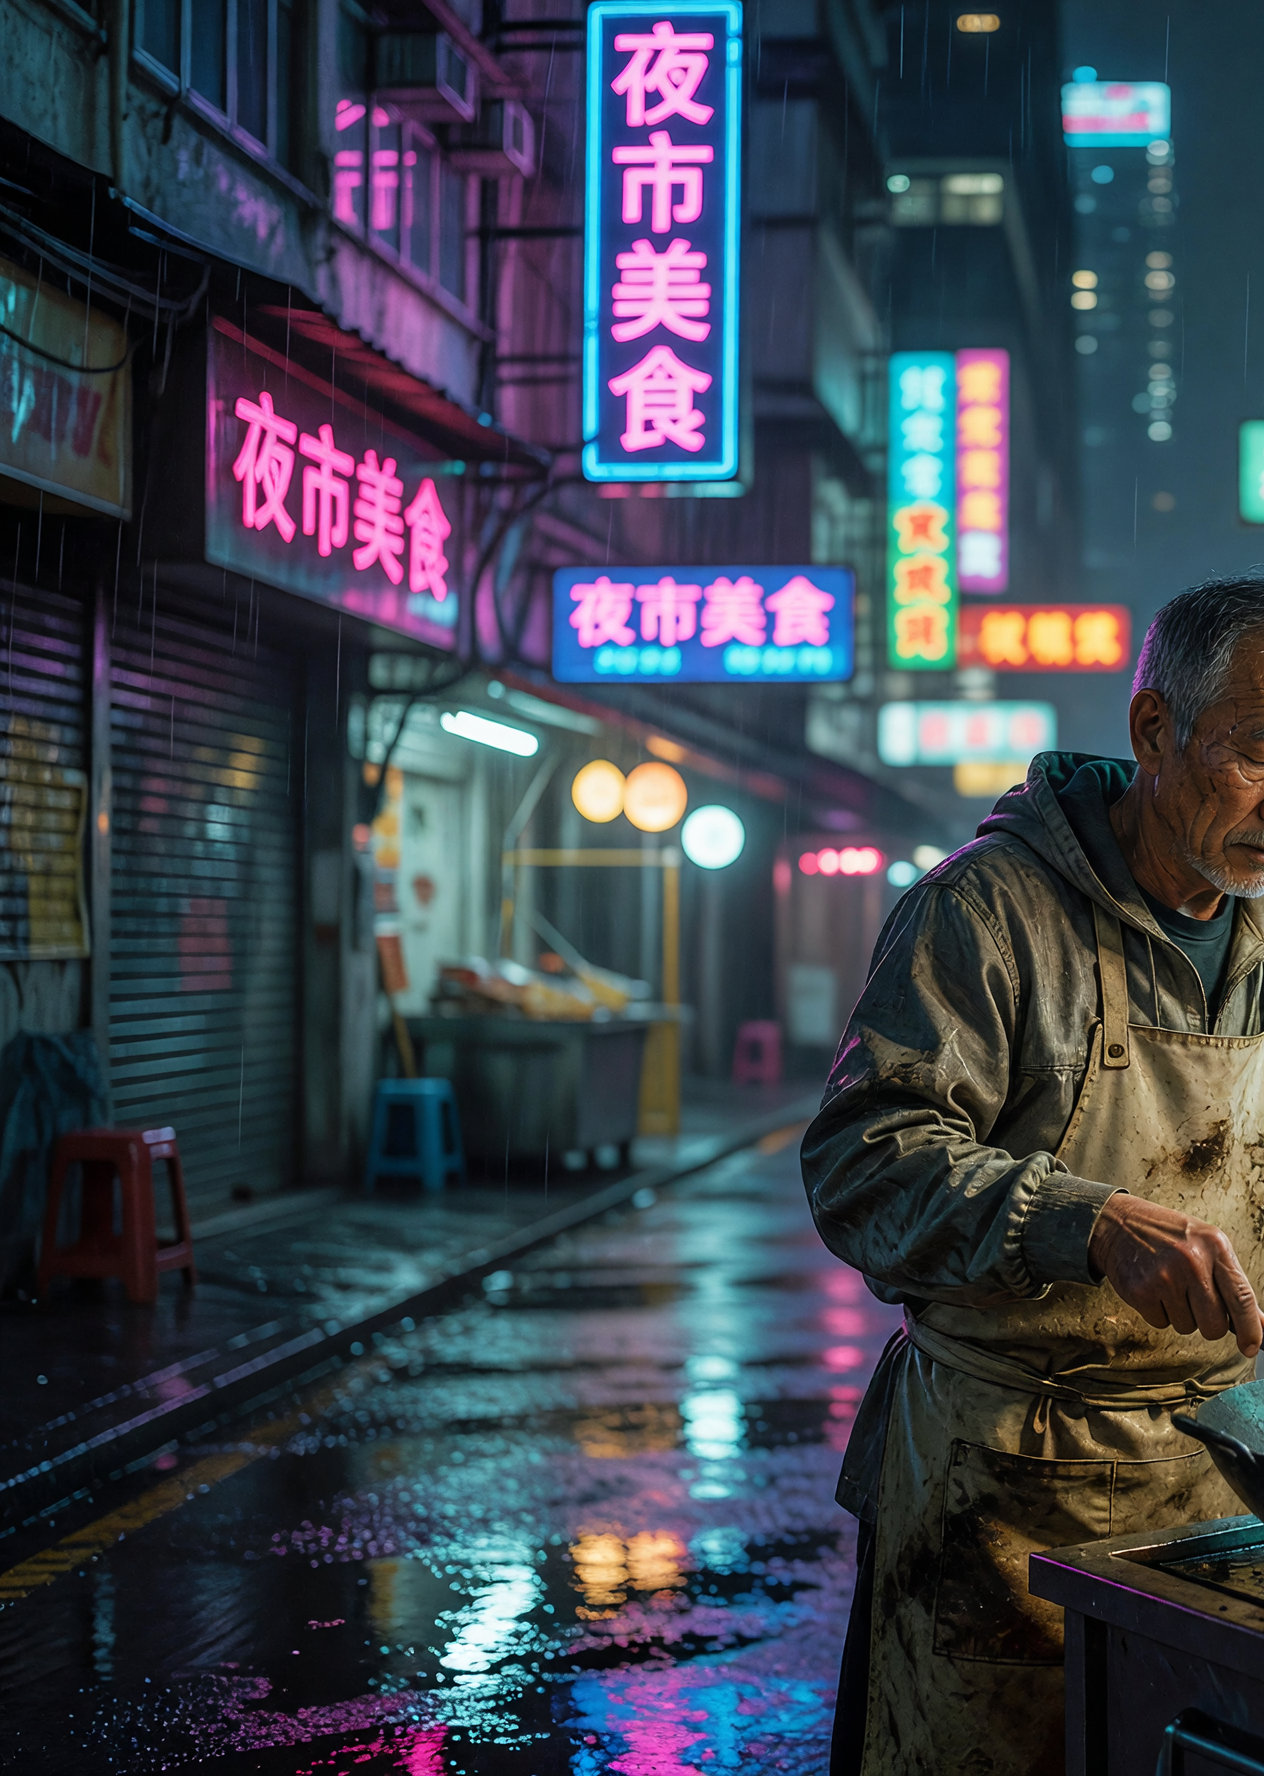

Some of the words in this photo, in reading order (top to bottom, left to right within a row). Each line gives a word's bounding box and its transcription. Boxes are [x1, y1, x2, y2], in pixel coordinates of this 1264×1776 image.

[608, 20, 715, 453] 夜市美食
[232, 391, 452, 603] 夜市美食
[568, 575, 836, 649] 夜市美食
